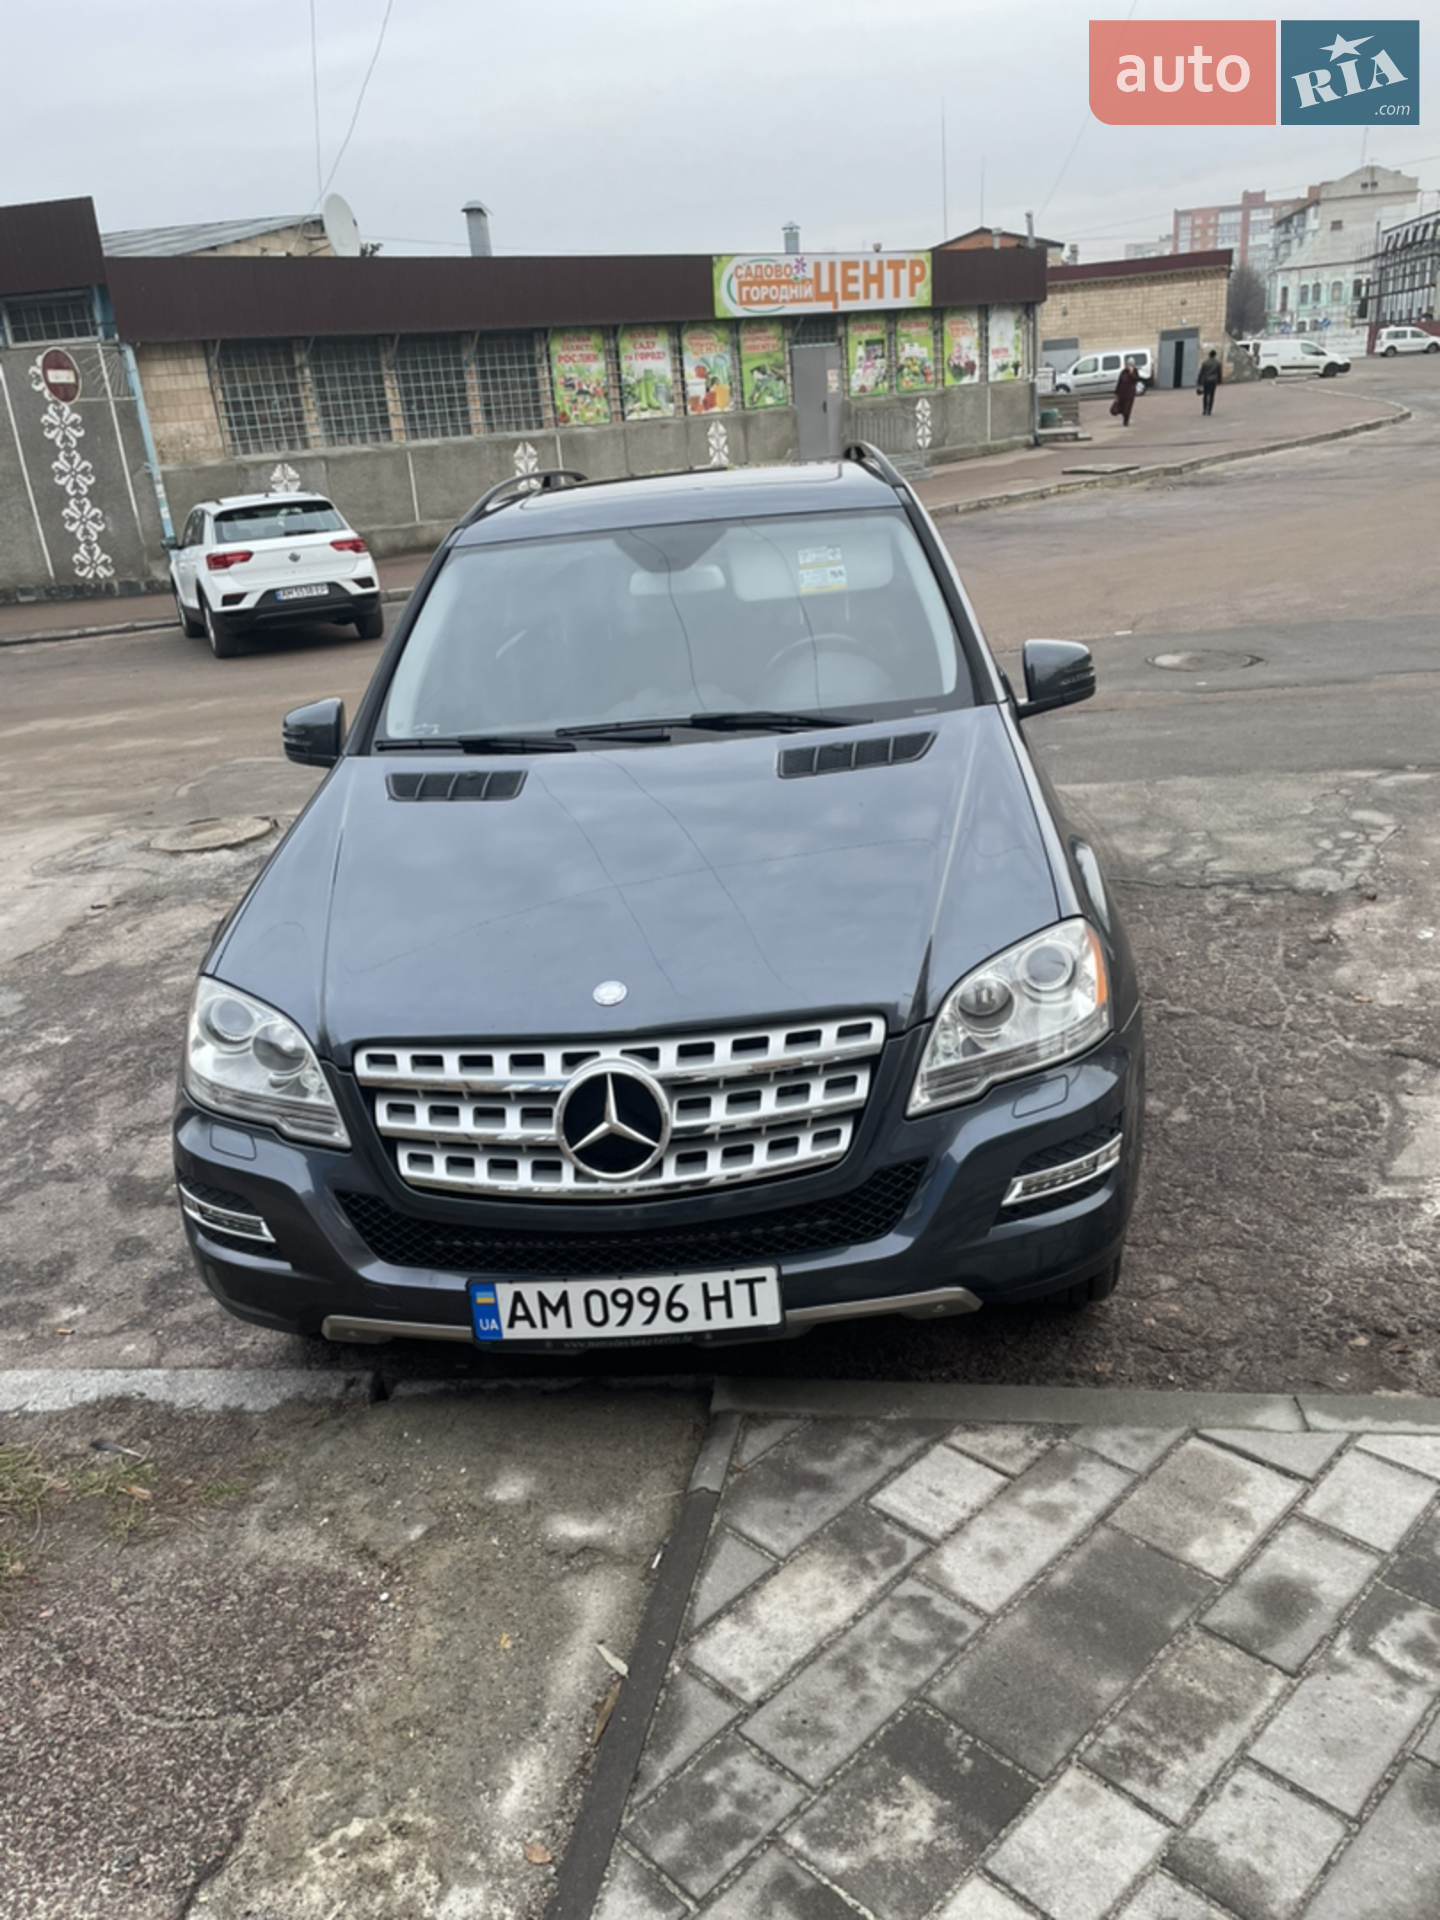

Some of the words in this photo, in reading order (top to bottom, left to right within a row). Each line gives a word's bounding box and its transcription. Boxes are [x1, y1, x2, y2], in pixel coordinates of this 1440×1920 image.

[742, 282, 814, 302] ГОРОДНІЙ
[814, 259, 926, 310] ЦЕНТР
[507, 1290, 572, 1329] AM
[583, 1284, 689, 1327] 0996
[701, 1276, 767, 1321] HT
[479, 1319, 499, 1331] UA
